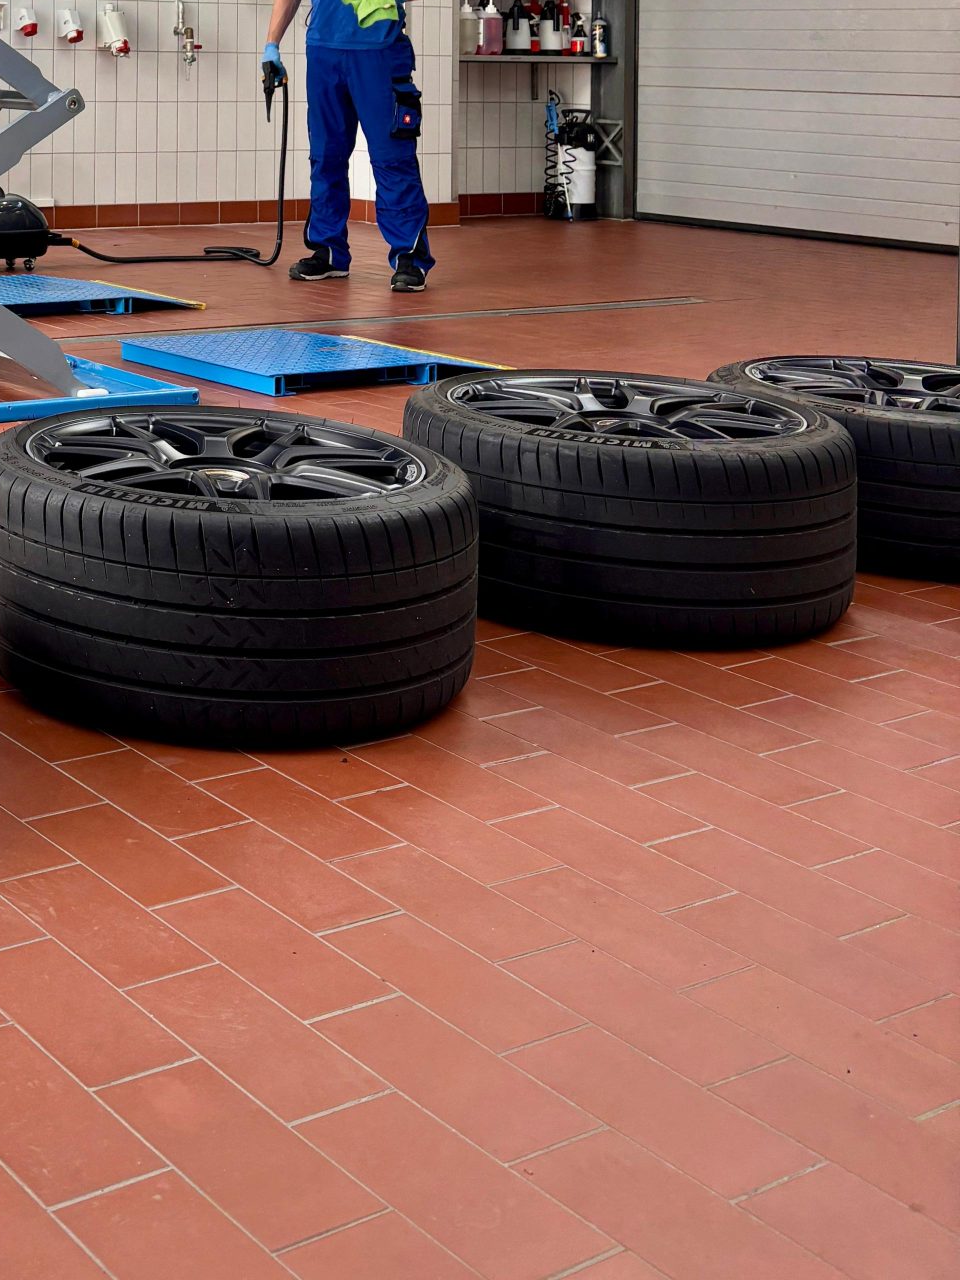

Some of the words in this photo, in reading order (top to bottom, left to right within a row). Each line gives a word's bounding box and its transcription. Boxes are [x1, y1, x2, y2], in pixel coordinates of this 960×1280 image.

[533, 427, 652, 448] MICHELIN
[44, 474, 68, 488] PILOT
[80, 483, 210, 510] MICHELIN
